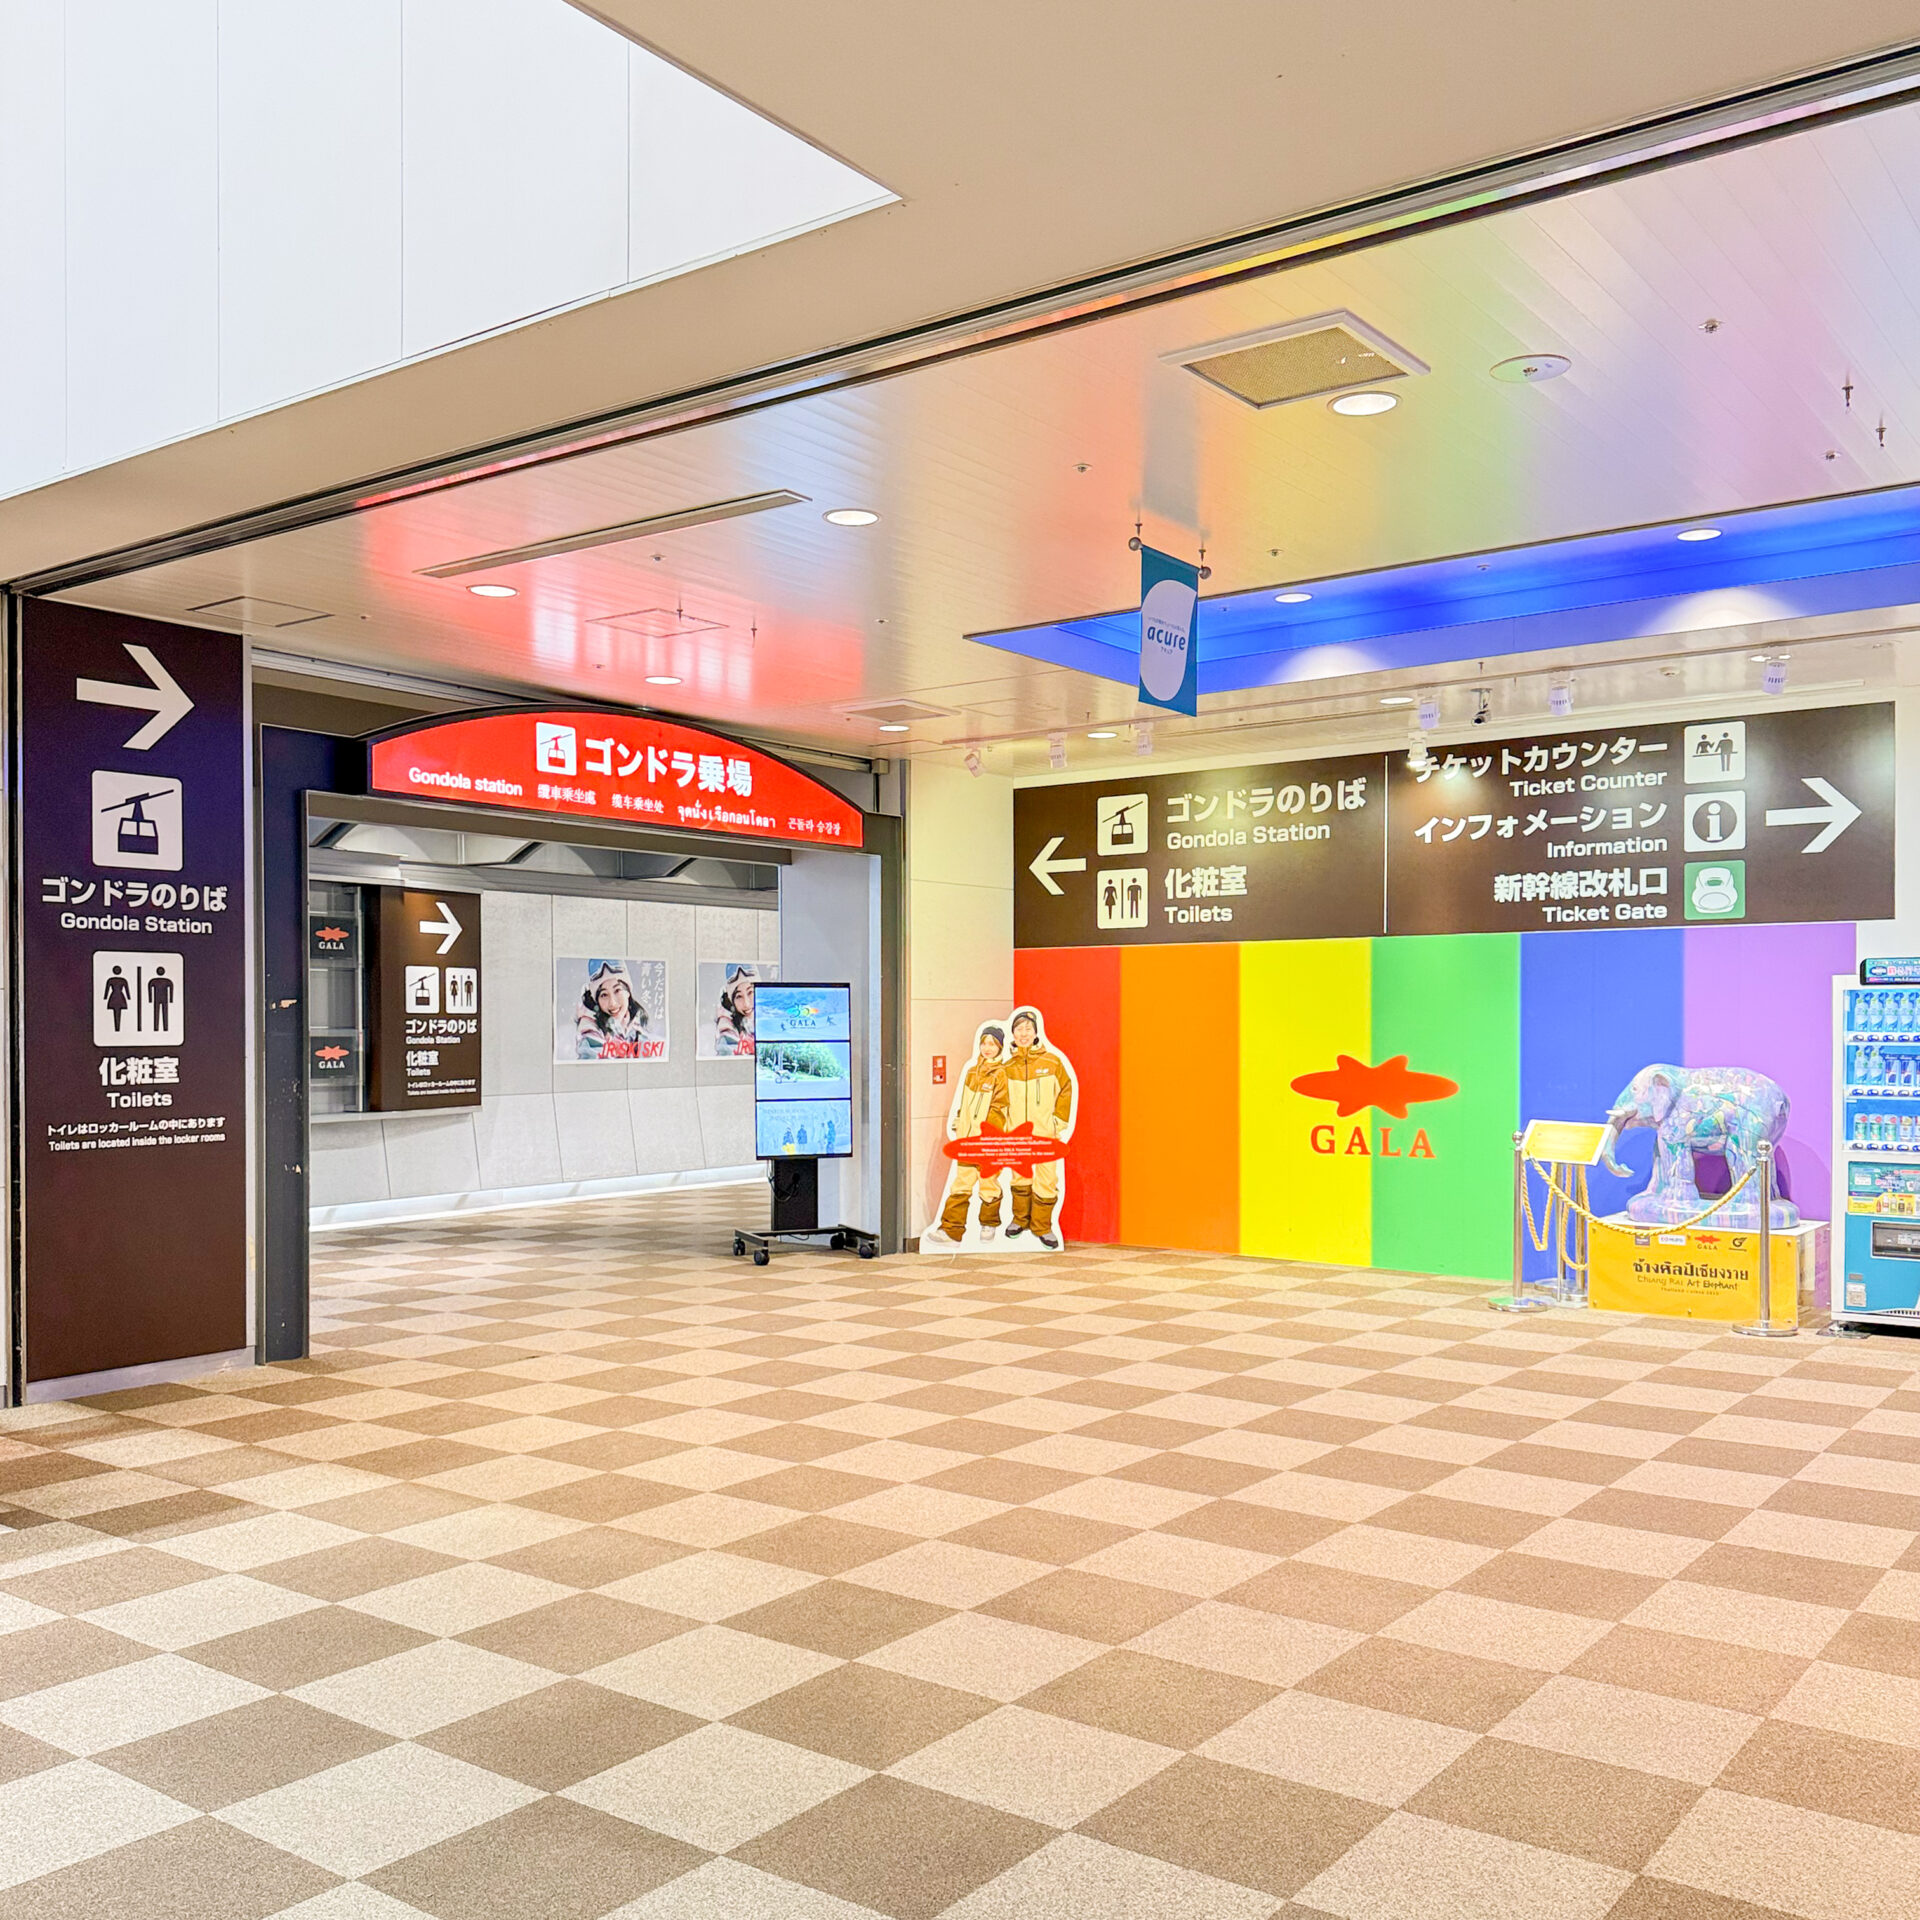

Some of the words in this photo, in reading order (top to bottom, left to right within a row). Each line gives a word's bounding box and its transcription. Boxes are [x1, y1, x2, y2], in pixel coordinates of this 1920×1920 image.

[1147, 626, 1186, 651] acure
[584, 736, 753, 798] ゴンドラ乗場
[1415, 735, 1668, 784] チケットカウンター
[408, 766, 472, 791] Gondola
[474, 771, 523, 797] station
[1509, 778, 1575, 798] Ticket
[1580, 769, 1668, 793] Counter
[1165, 776, 1367, 824] ゴンドラのりば
[788, 817, 814, 832] 곤돌라
[816, 820, 841, 836] 승강장
[1414, 801, 1668, 843] インフォメーション
[1167, 828, 1247, 850] Gondola
[1252, 823, 1331, 845] Station
[1547, 836, 1668, 859] Information
[1164, 865, 1248, 899] 化粧室
[1494, 867, 1668, 902] 新幹線改札口
[41, 876, 228, 913] ゴンドラのりば
[61, 911, 140, 933] Gondola
[144, 915, 213, 934] Station
[1164, 904, 1233, 924] Toilets
[1542, 905, 1610, 923] Ticket
[1615, 902, 1668, 920] Gate
[318, 941, 345, 951] GALA
[654, 962, 665, 1020] 今だけは
[405, 1019, 477, 1034] ゴンドラのりば
[789, 1019, 817, 1027] GALA
[405, 1036, 434, 1044] Gondola
[435, 1035, 461, 1044] Station
[318, 1060, 345, 1069] GALA
[406, 1050, 439, 1067] 化粧室
[99, 1056, 180, 1085] 化粧室
[406, 1068, 431, 1076] Toilets
[107, 1089, 173, 1108] Toilets
[47, 1116, 226, 1137] トイレはロッカールームの中にあります
[49, 1140, 80, 1151] Toilets
[81, 1140, 97, 1150] are
[98, 1137, 131, 1149] located
[132, 1136, 157, 1147] inside
[158, 1134, 173, 1145] the
[174, 1133, 200, 1144] locker
[200, 1132, 226, 1143] rooms
[1310, 1125, 1436, 1158] GALA
[1686, 1279, 1701, 1288] Art
[1703, 1280, 1739, 1291] Elephant
